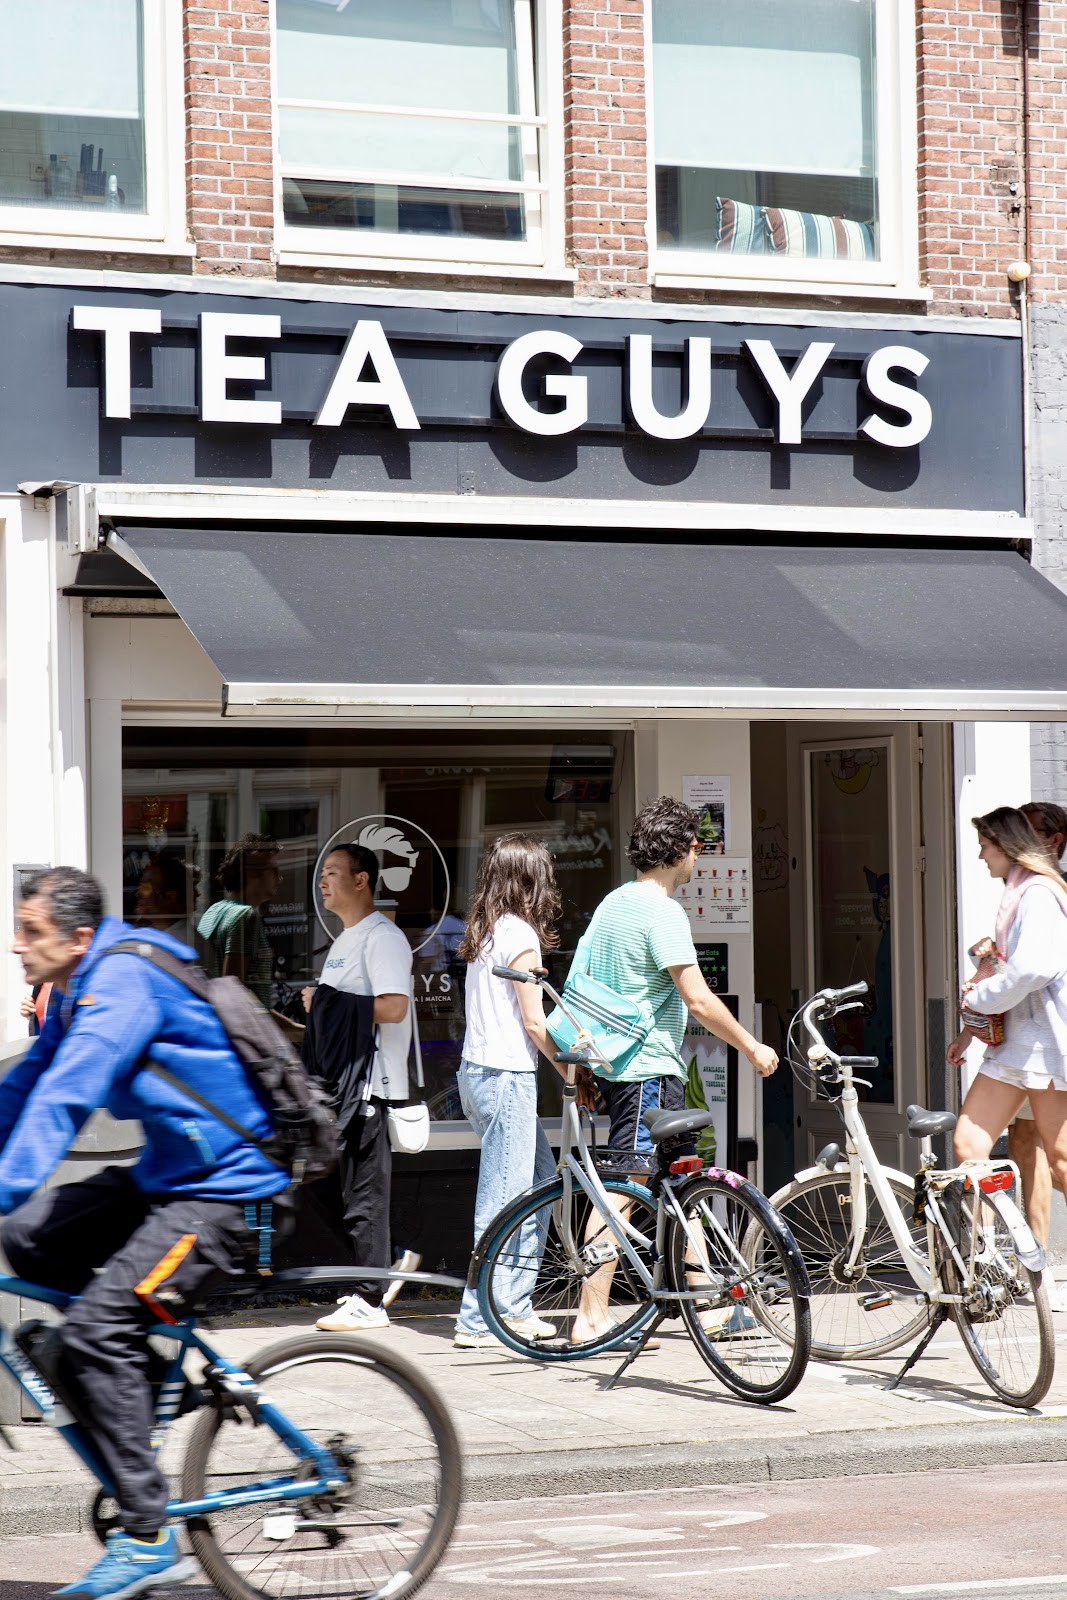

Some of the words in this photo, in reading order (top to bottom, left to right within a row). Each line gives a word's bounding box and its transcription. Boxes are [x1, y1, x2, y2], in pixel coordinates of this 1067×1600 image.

[72, 305, 421, 430] TEA
[496, 330, 933, 448] GUYS
[706, 976, 718, 988] 23
